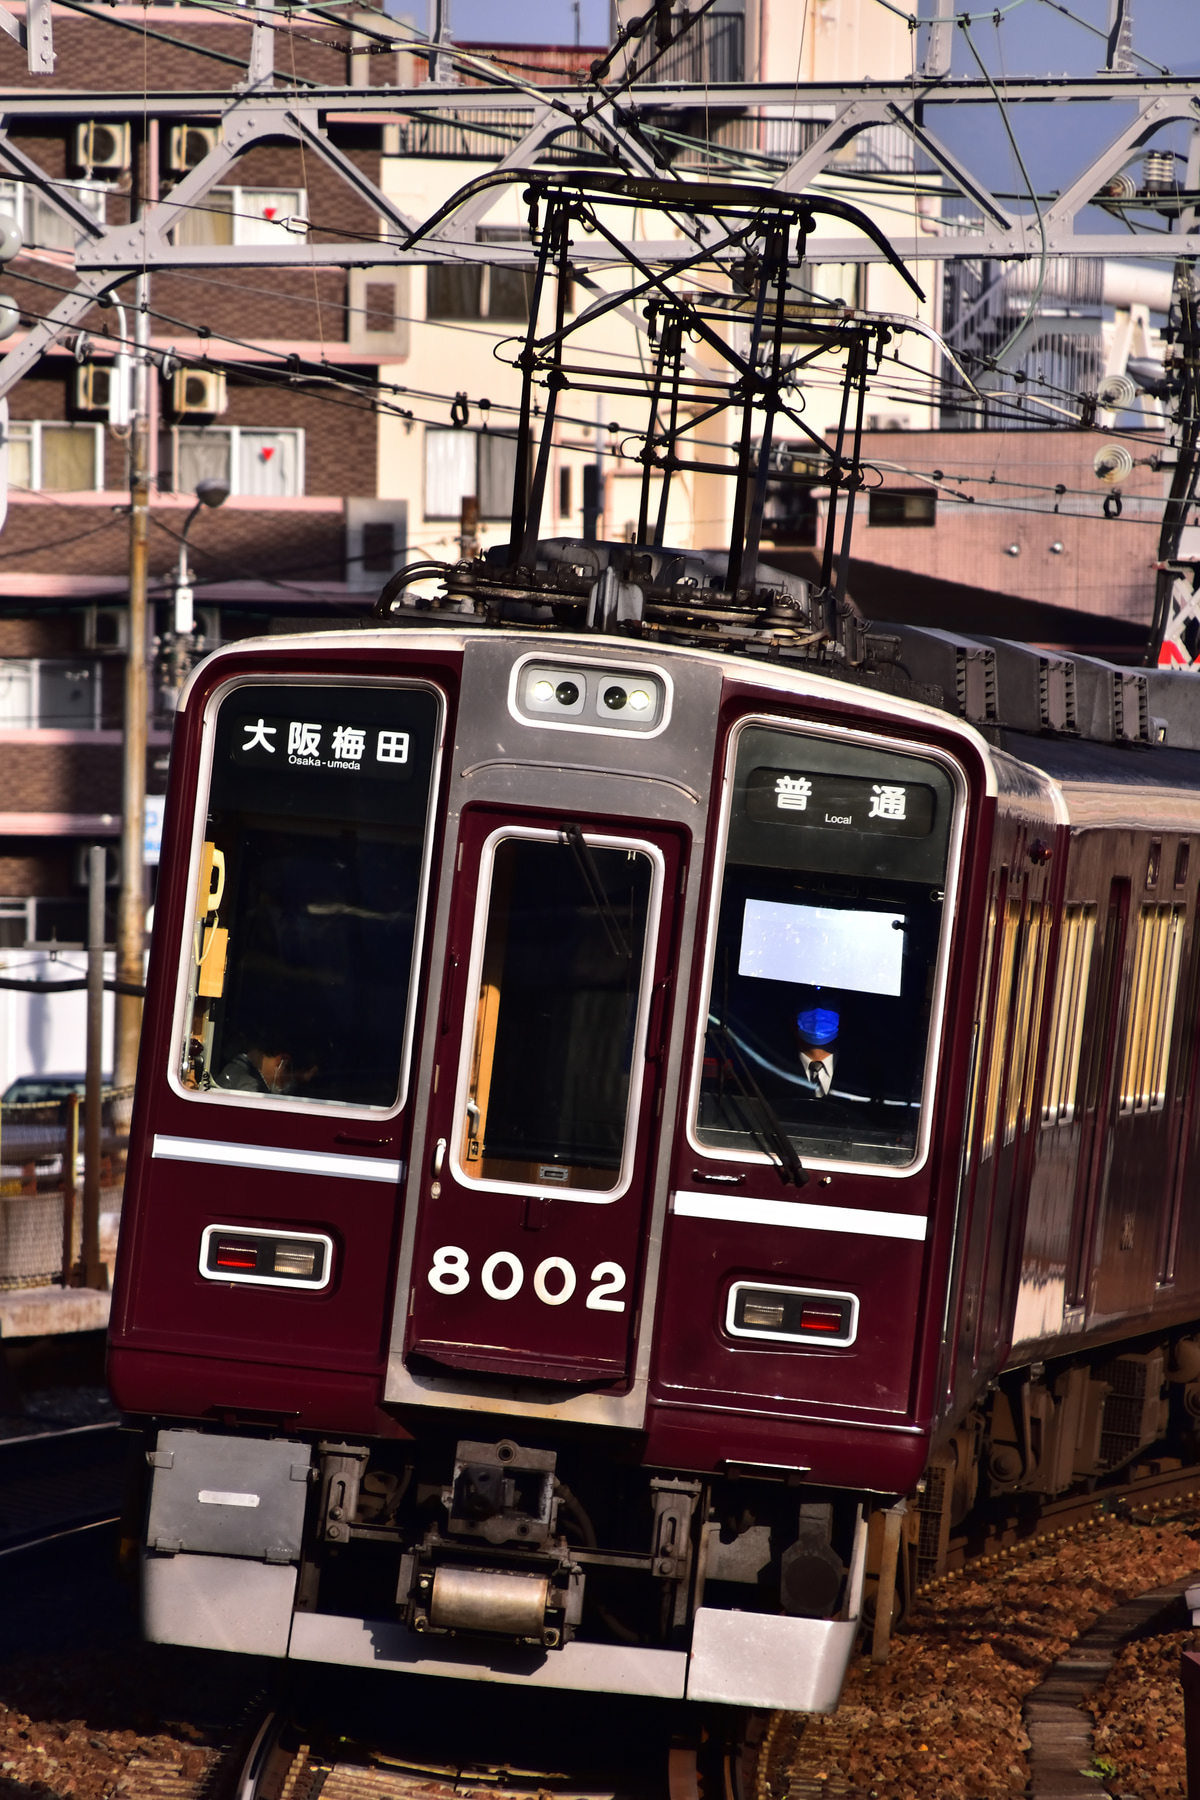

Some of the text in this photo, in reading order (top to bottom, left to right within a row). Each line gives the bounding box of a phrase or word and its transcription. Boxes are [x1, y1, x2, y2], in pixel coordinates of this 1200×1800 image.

[242, 719, 410, 764] 大阪梅田
[288, 754, 361, 770] Osaka-umeda
[774, 776, 906, 820] 普通
[825, 813, 852, 825] Local
[427, 1245, 626, 1313] 8002
